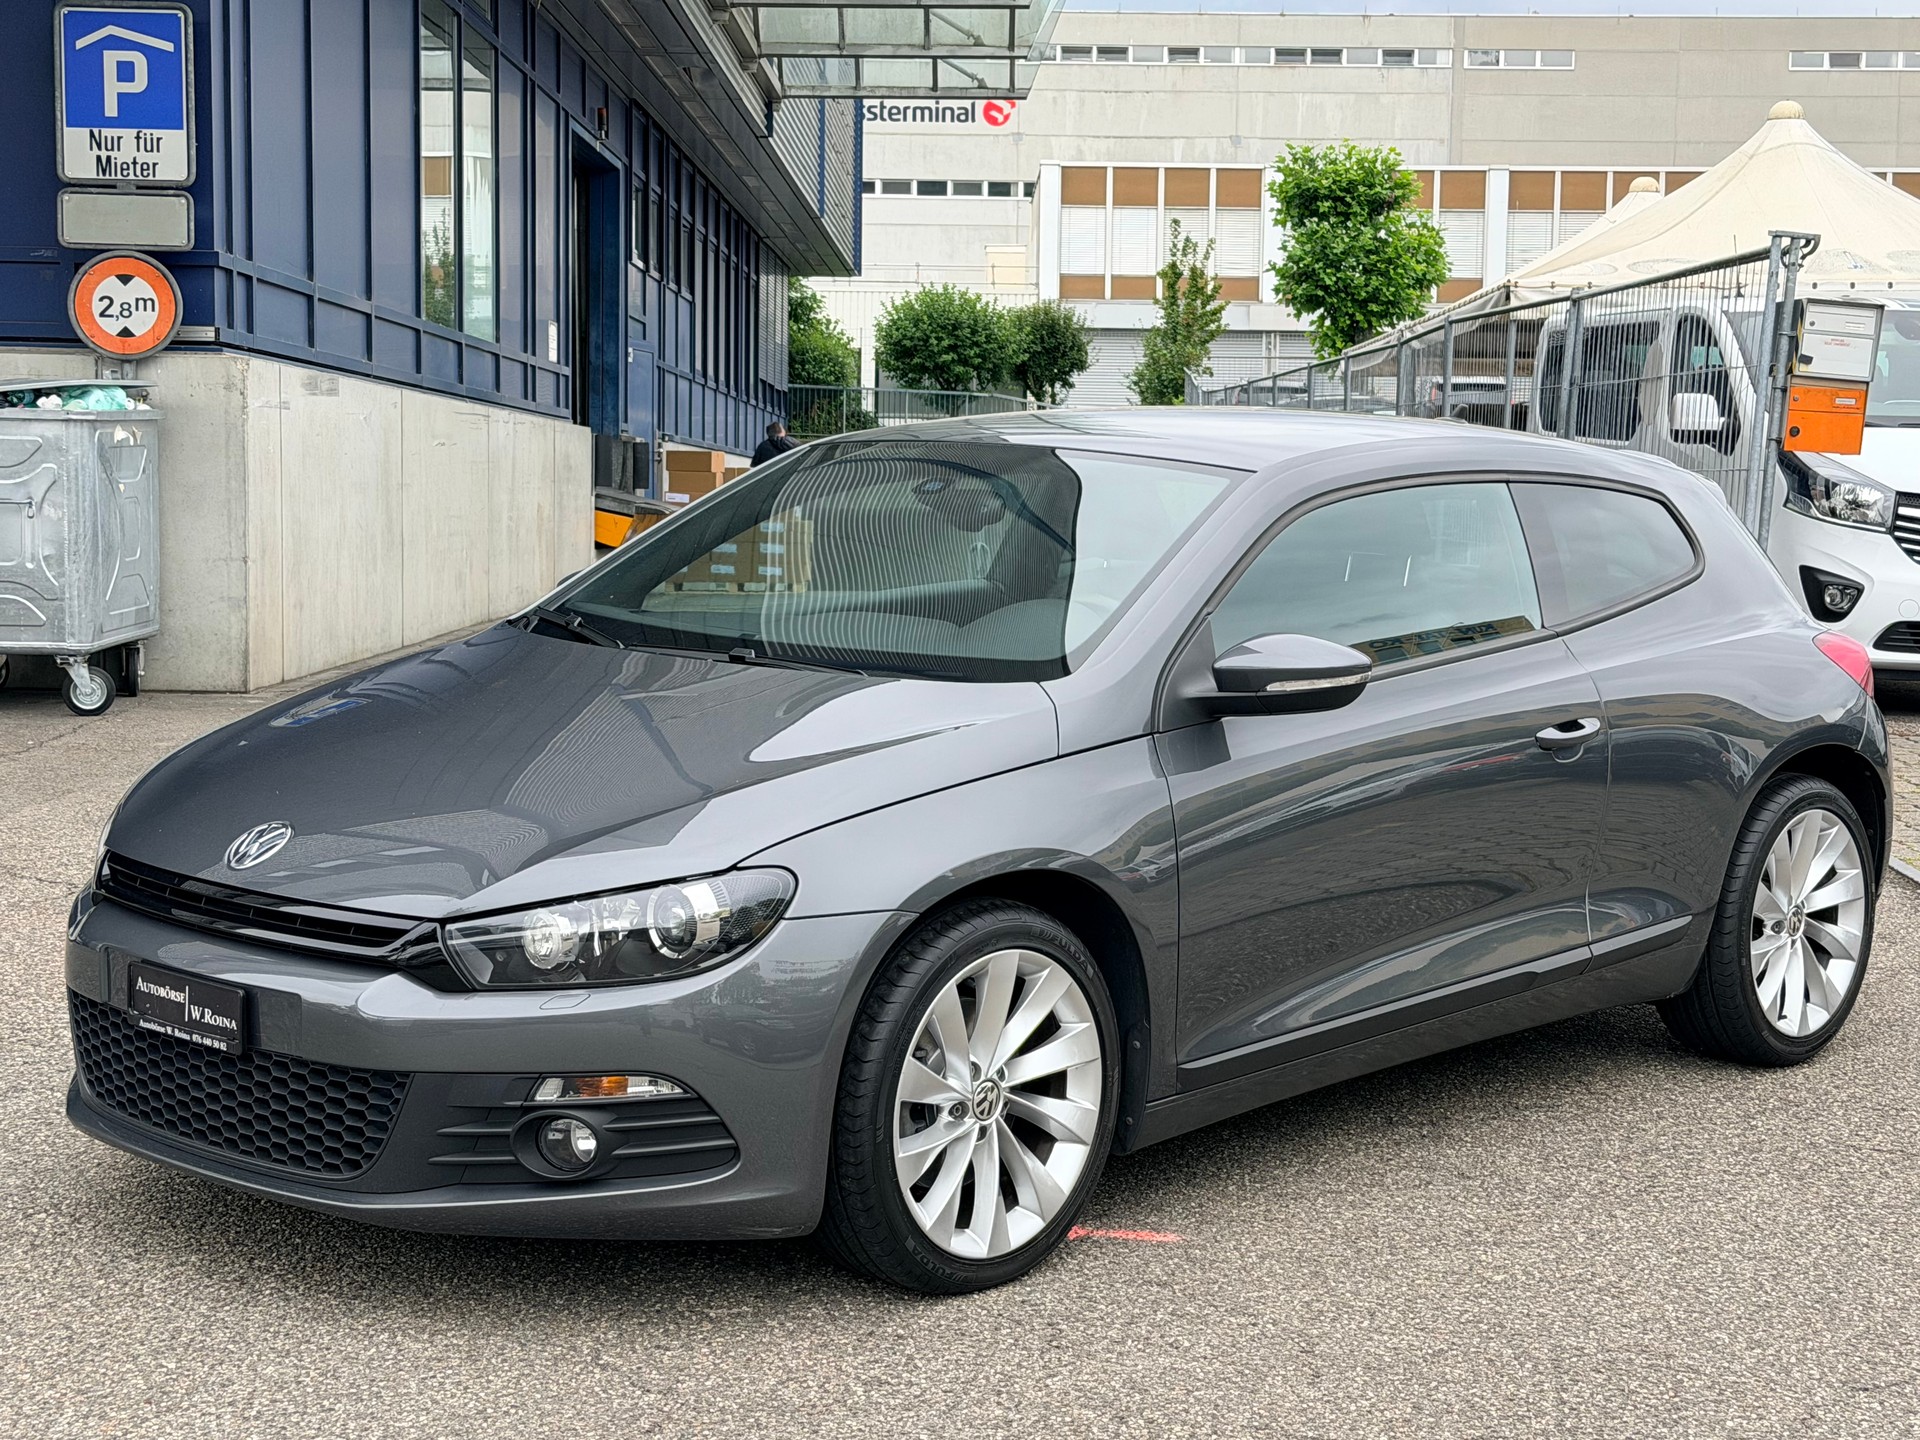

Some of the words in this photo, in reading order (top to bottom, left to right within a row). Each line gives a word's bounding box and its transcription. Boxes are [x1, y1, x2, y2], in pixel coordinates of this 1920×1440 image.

[103, 50, 149, 118] P
[862, 100, 976, 123] sterminal
[89, 129, 123, 152] Nur
[134, 130, 164, 154] für
[95, 155, 159, 179] Mieter
